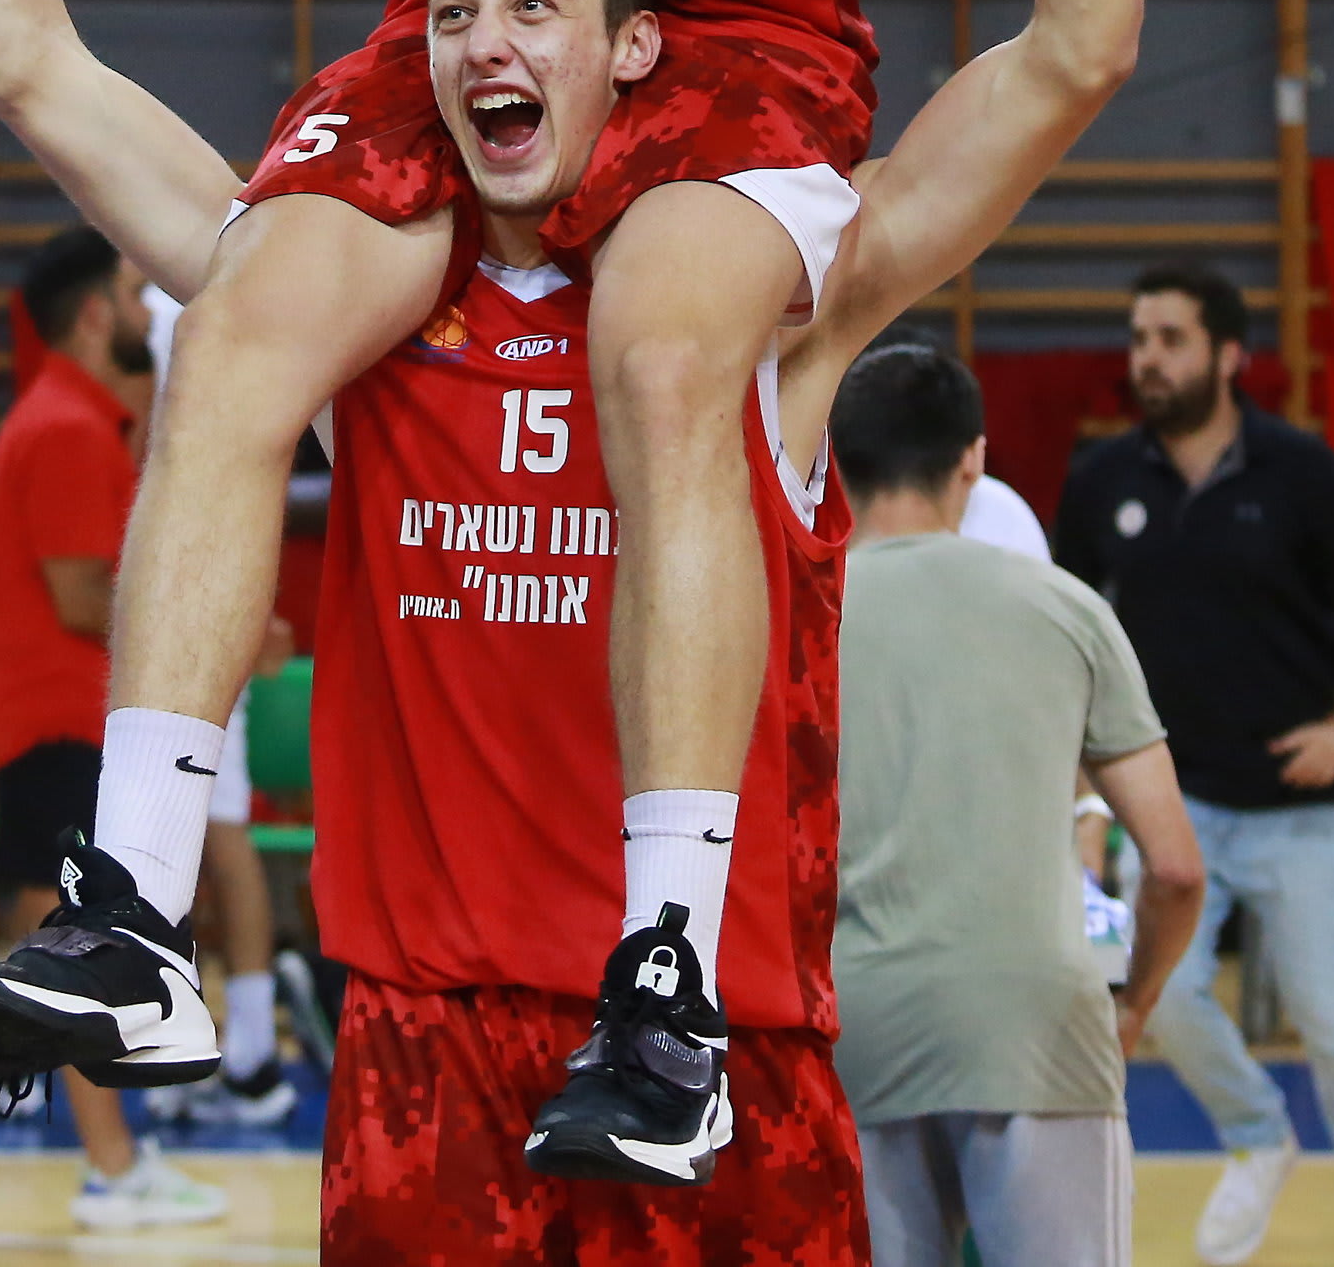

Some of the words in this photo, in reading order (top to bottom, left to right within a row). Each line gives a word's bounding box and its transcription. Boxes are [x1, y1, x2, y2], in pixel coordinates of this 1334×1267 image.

[282, 113, 350, 163] 5
[500, 389, 572, 473] 15
[399, 498, 536, 554] נשארים
